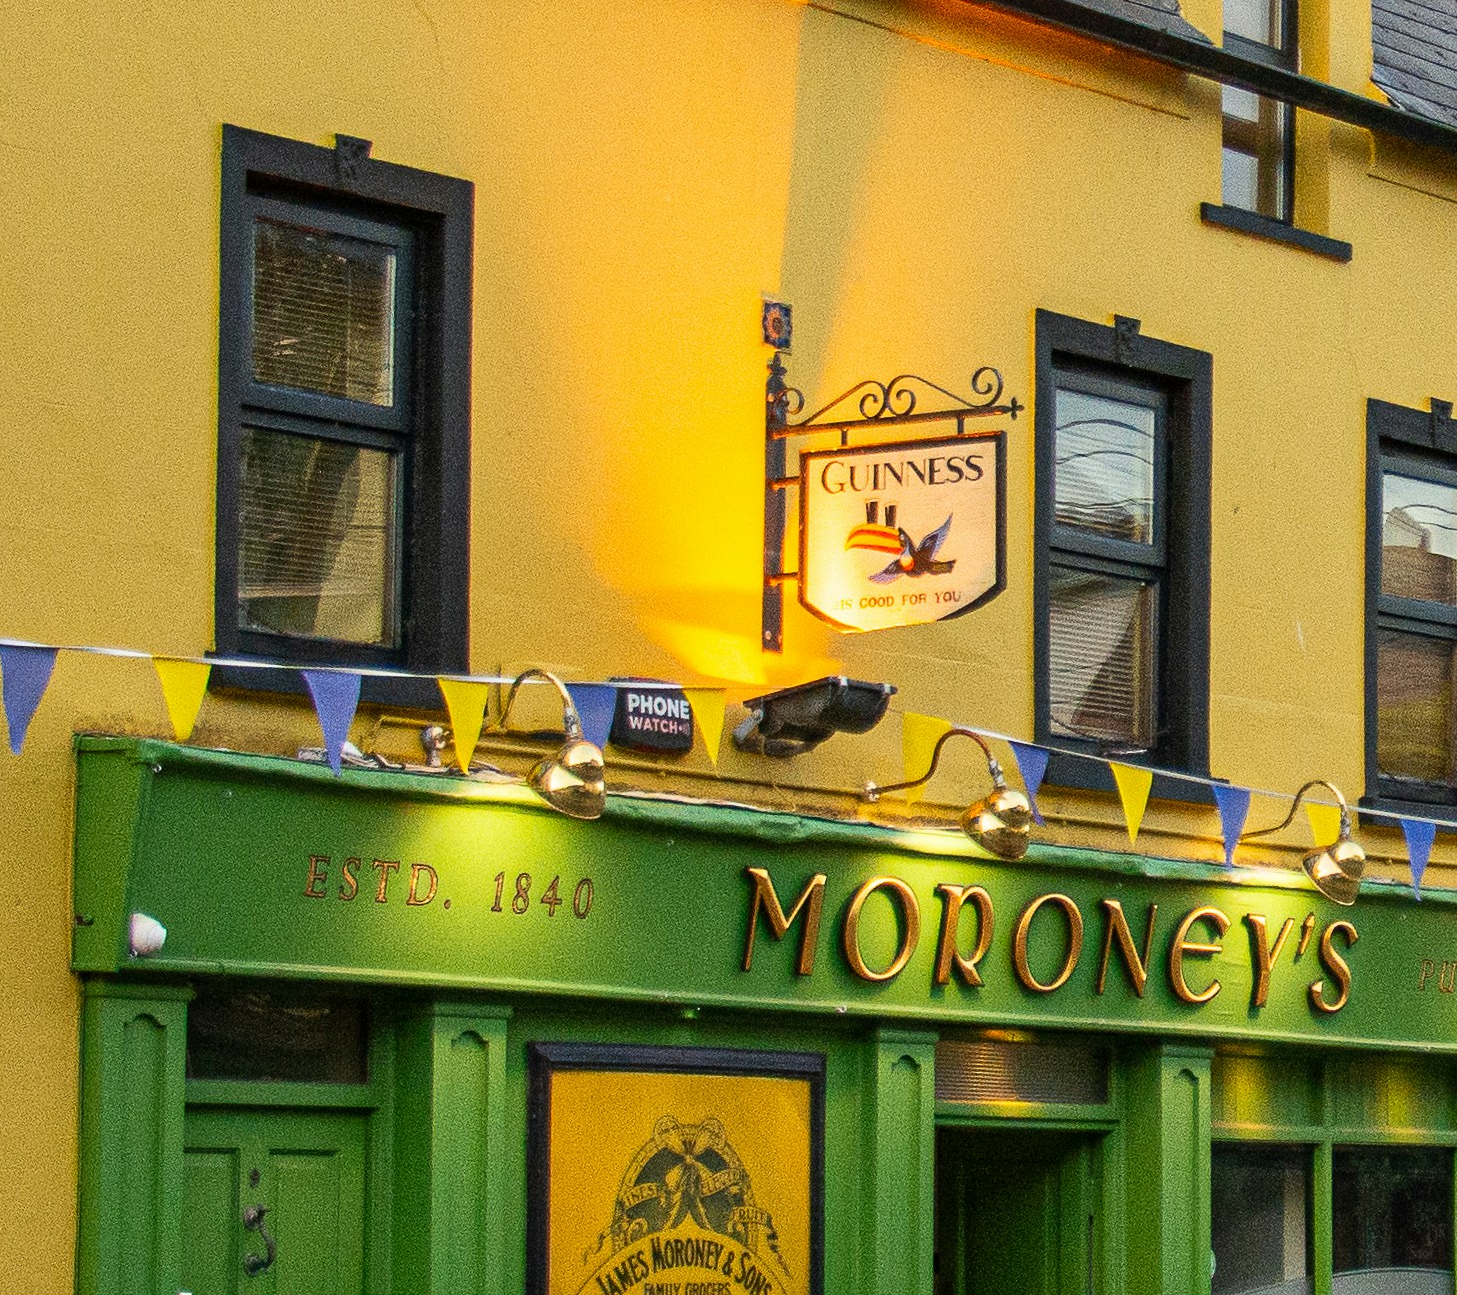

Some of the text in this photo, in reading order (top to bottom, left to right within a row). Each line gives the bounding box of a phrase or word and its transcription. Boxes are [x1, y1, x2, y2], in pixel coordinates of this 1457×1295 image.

[821, 454, 984, 495] GUINNESS
[859, 595, 894, 610] GOOD
[902, 593, 927, 606] FOR
[934, 590, 963, 605] YOU
[627, 693, 691, 720] PHONE
[628, 716, 679, 735] WATCH
[302, 855, 593, 920] ESTD. 1840
[743, 865, 1359, 1014] MORONEY'S
[651, 1237, 724, 1273] MORONEY
